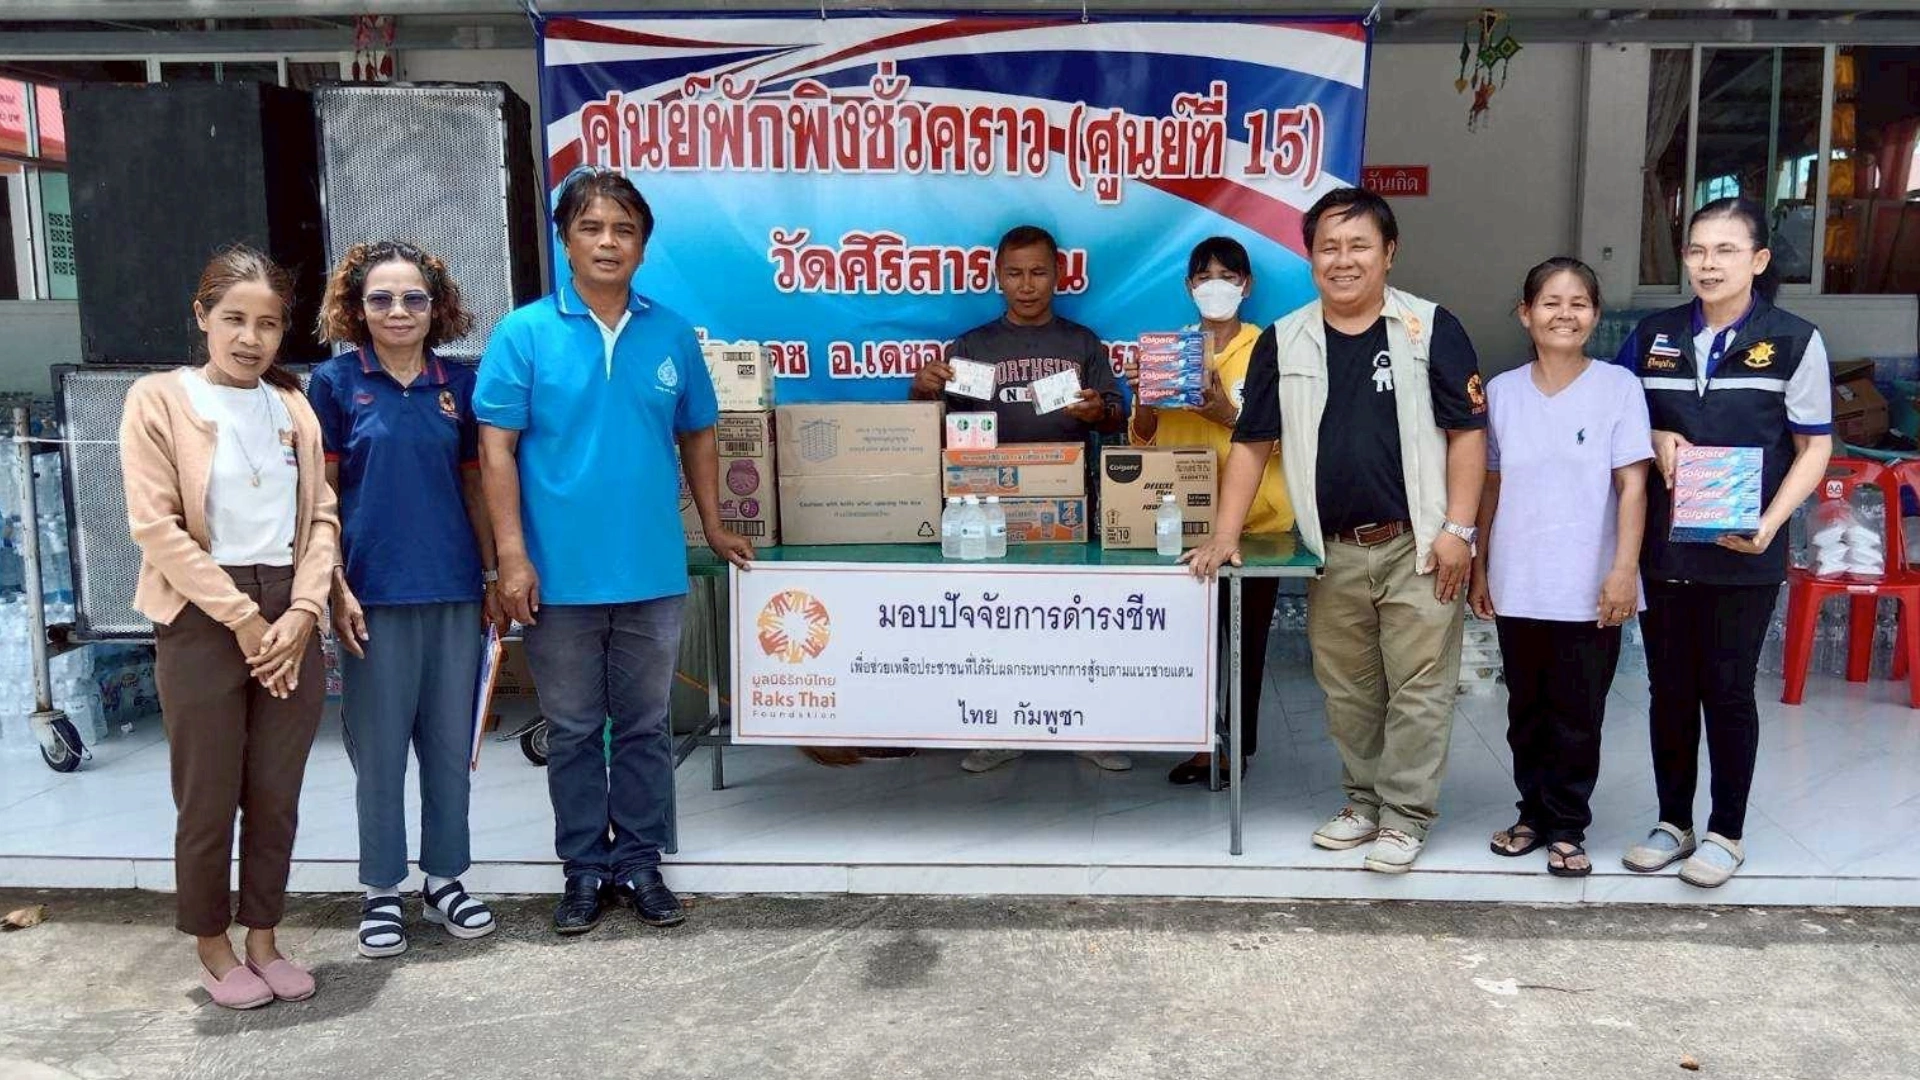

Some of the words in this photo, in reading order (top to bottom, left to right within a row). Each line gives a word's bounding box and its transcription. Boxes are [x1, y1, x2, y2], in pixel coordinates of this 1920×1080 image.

[580, 60, 1047, 174] ศนย์พักพิงชั่วคราว
[1068, 83, 1226, 201] (ศูนย์ที่
[1243, 106, 1323, 188] 15)
[1361, 170, 1419, 192] วันเกิด
[1680, 449, 1726, 458] Colgate
[878, 592, 1167, 631] มอบปัจจัยการดำรงชีพ
[752, 691, 795, 707] Raks
[798, 691, 836, 708] Thai
[752, 711, 836, 719] Foundation
[958, 699, 998, 726] ไทย
[1012, 701, 1084, 735] กัมพูชา
